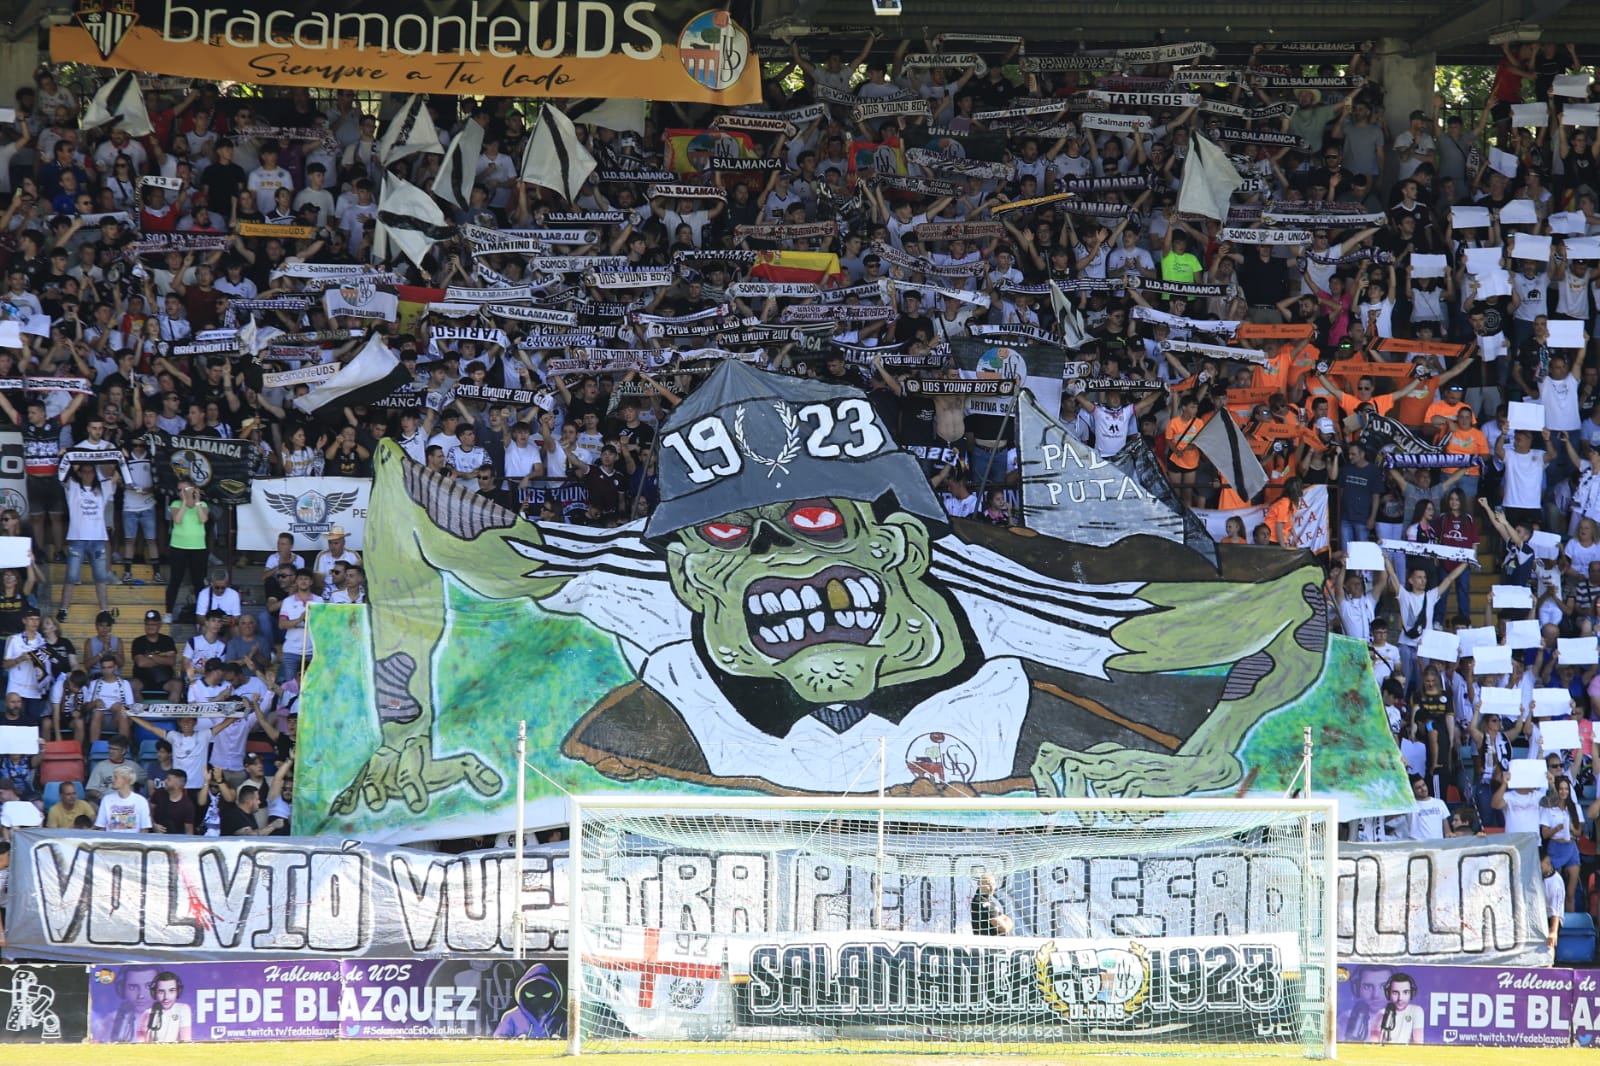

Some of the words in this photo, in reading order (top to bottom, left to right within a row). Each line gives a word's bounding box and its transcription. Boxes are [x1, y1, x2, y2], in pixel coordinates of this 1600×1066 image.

[1124, 50, 1151, 62] SOMOS
[248, 53, 389, 85] Siempre
[406, 68, 433, 81] a
[434, 61, 483, 90] Tu
[502, 63, 577, 93] lado
[1108, 93, 1183, 106] TARUSOS
[805, 106, 825, 119] UDS
[729, 116, 787, 131] SALAMANCA
[1097, 116, 1145, 129] Salmanto
[713, 157, 782, 169] SALAMANCA
[1069, 173, 1146, 191] SALAMANCA
[676, 187, 728, 197] SALAMANC
[470, 227, 497, 243] SOMOS
[1228, 229, 1257, 241] SOMOS
[1273, 230, 1284, 241] LA
[293, 265, 305, 273] CF
[307, 264, 357, 275] Salmantino
[539, 260, 568, 270] SOMOS
[599, 274, 617, 285] UDS
[618, 273, 648, 283] YOUNG
[739, 284, 766, 295] SOMOS
[782, 284, 794, 295] LA
[507, 307, 569, 323] SALAMANCA
[922, 381, 940, 393] UDS
[943, 381, 973, 393] YOUNG
[974, 381, 999, 393] BOYS
[172, 436, 243, 459] SALAMANCA
[663, 416, 743, 482] 19
[799, 402, 887, 458] 23
[1393, 453, 1472, 467] SALAMANCA
[517, 487, 546, 504] UDS
[1046, 476, 1157, 506] PUTA
[353, 508, 367, 519] PE
[33, 839, 367, 951] VOLVIÓ
[263, 963, 341, 984] Hablemos
[345, 965, 365, 982] de
[367, 963, 413, 983] UDS
[749, 943, 1048, 1016] SALAMANCA
[1146, 943, 1283, 1013] 1923
[1496, 971, 1574, 992] Hablemos
[1578, 974, 1597, 992] de
[196, 986, 284, 1026] FEDE
[294, 985, 479, 1025] BLAZQUEZ
[1069, 1003, 1126, 1019] ULTRAS
[1430, 992, 1516, 1029] FEDE
[1033, 1026, 1063, 1037] 623
